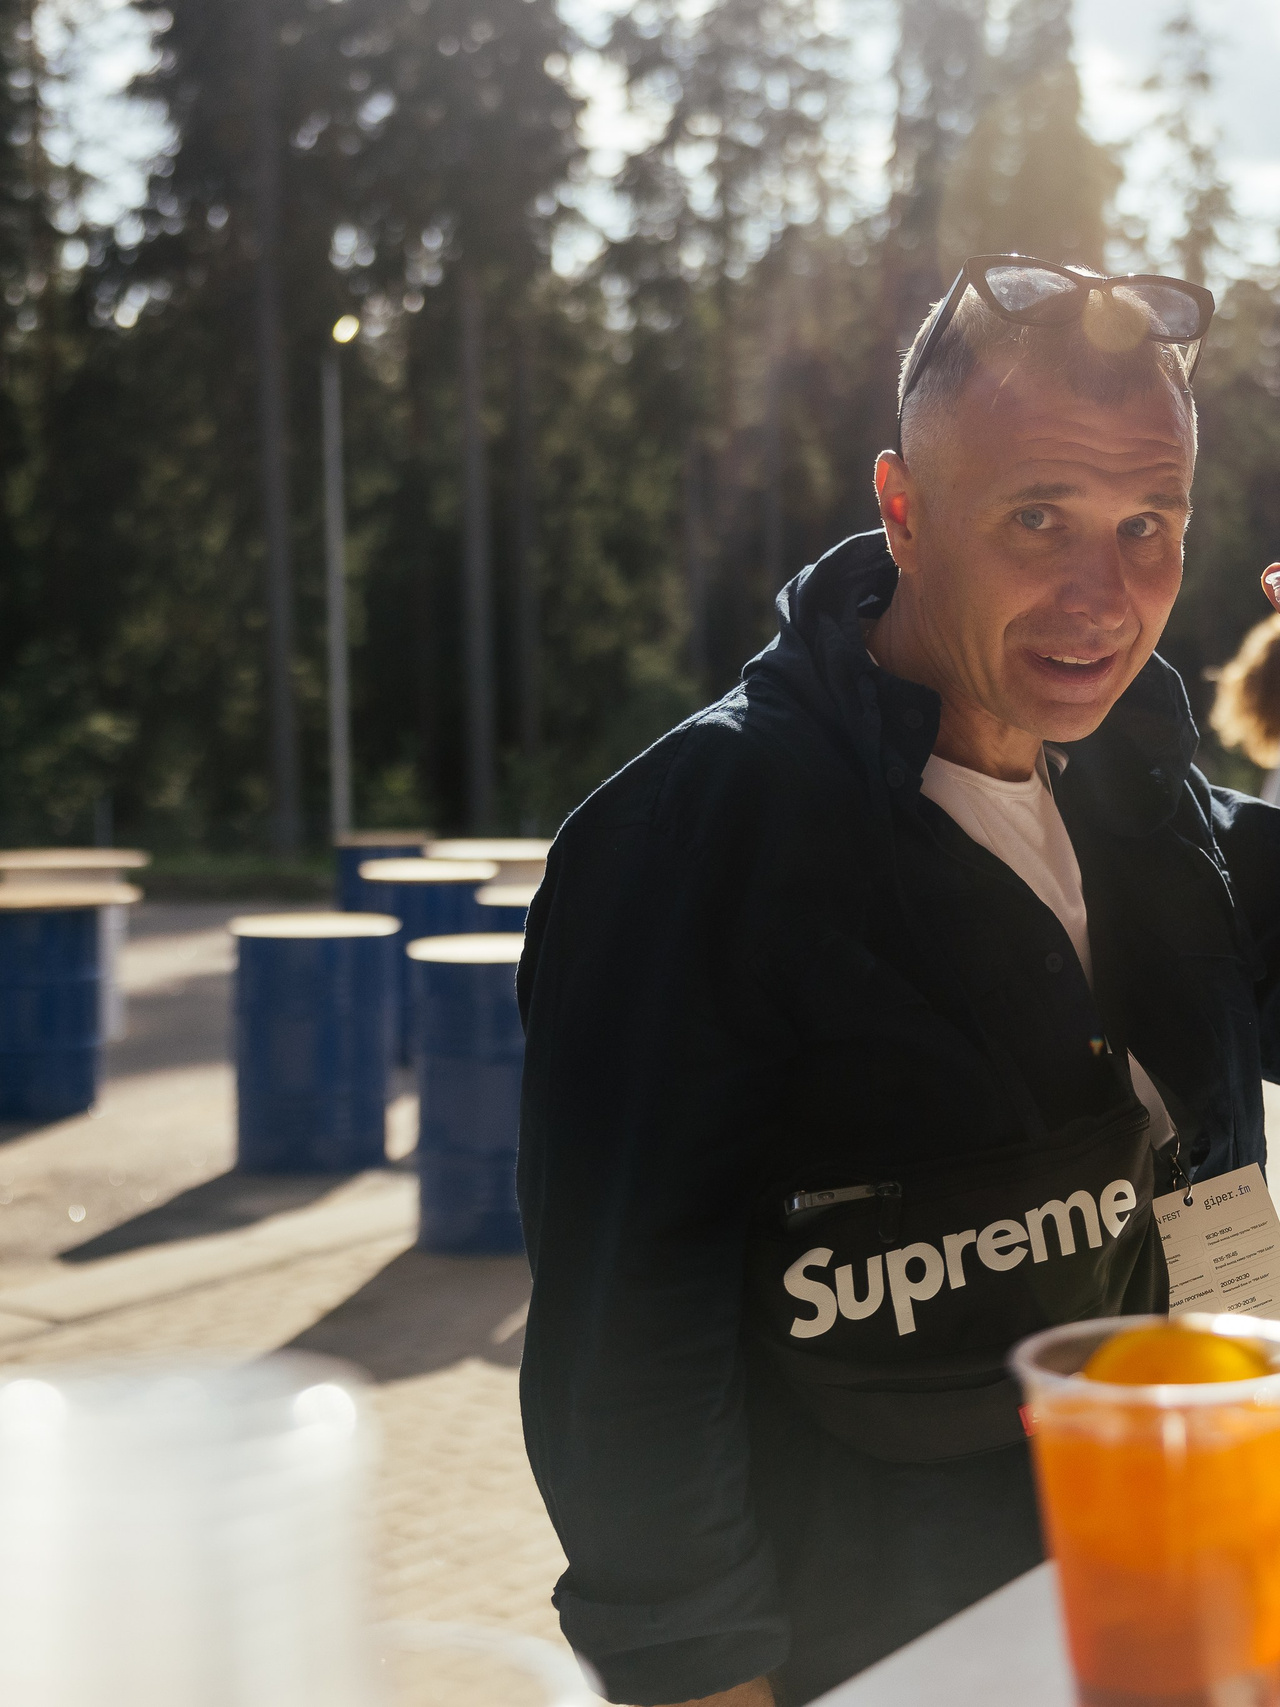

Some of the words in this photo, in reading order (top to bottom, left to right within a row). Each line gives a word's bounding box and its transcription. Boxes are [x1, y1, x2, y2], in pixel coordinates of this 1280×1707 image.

[1203, 1184, 1251, 1210] giper.fm
[1162, 1210, 1180, 1223] FEST
[783, 1179, 1137, 1338] Supreme
